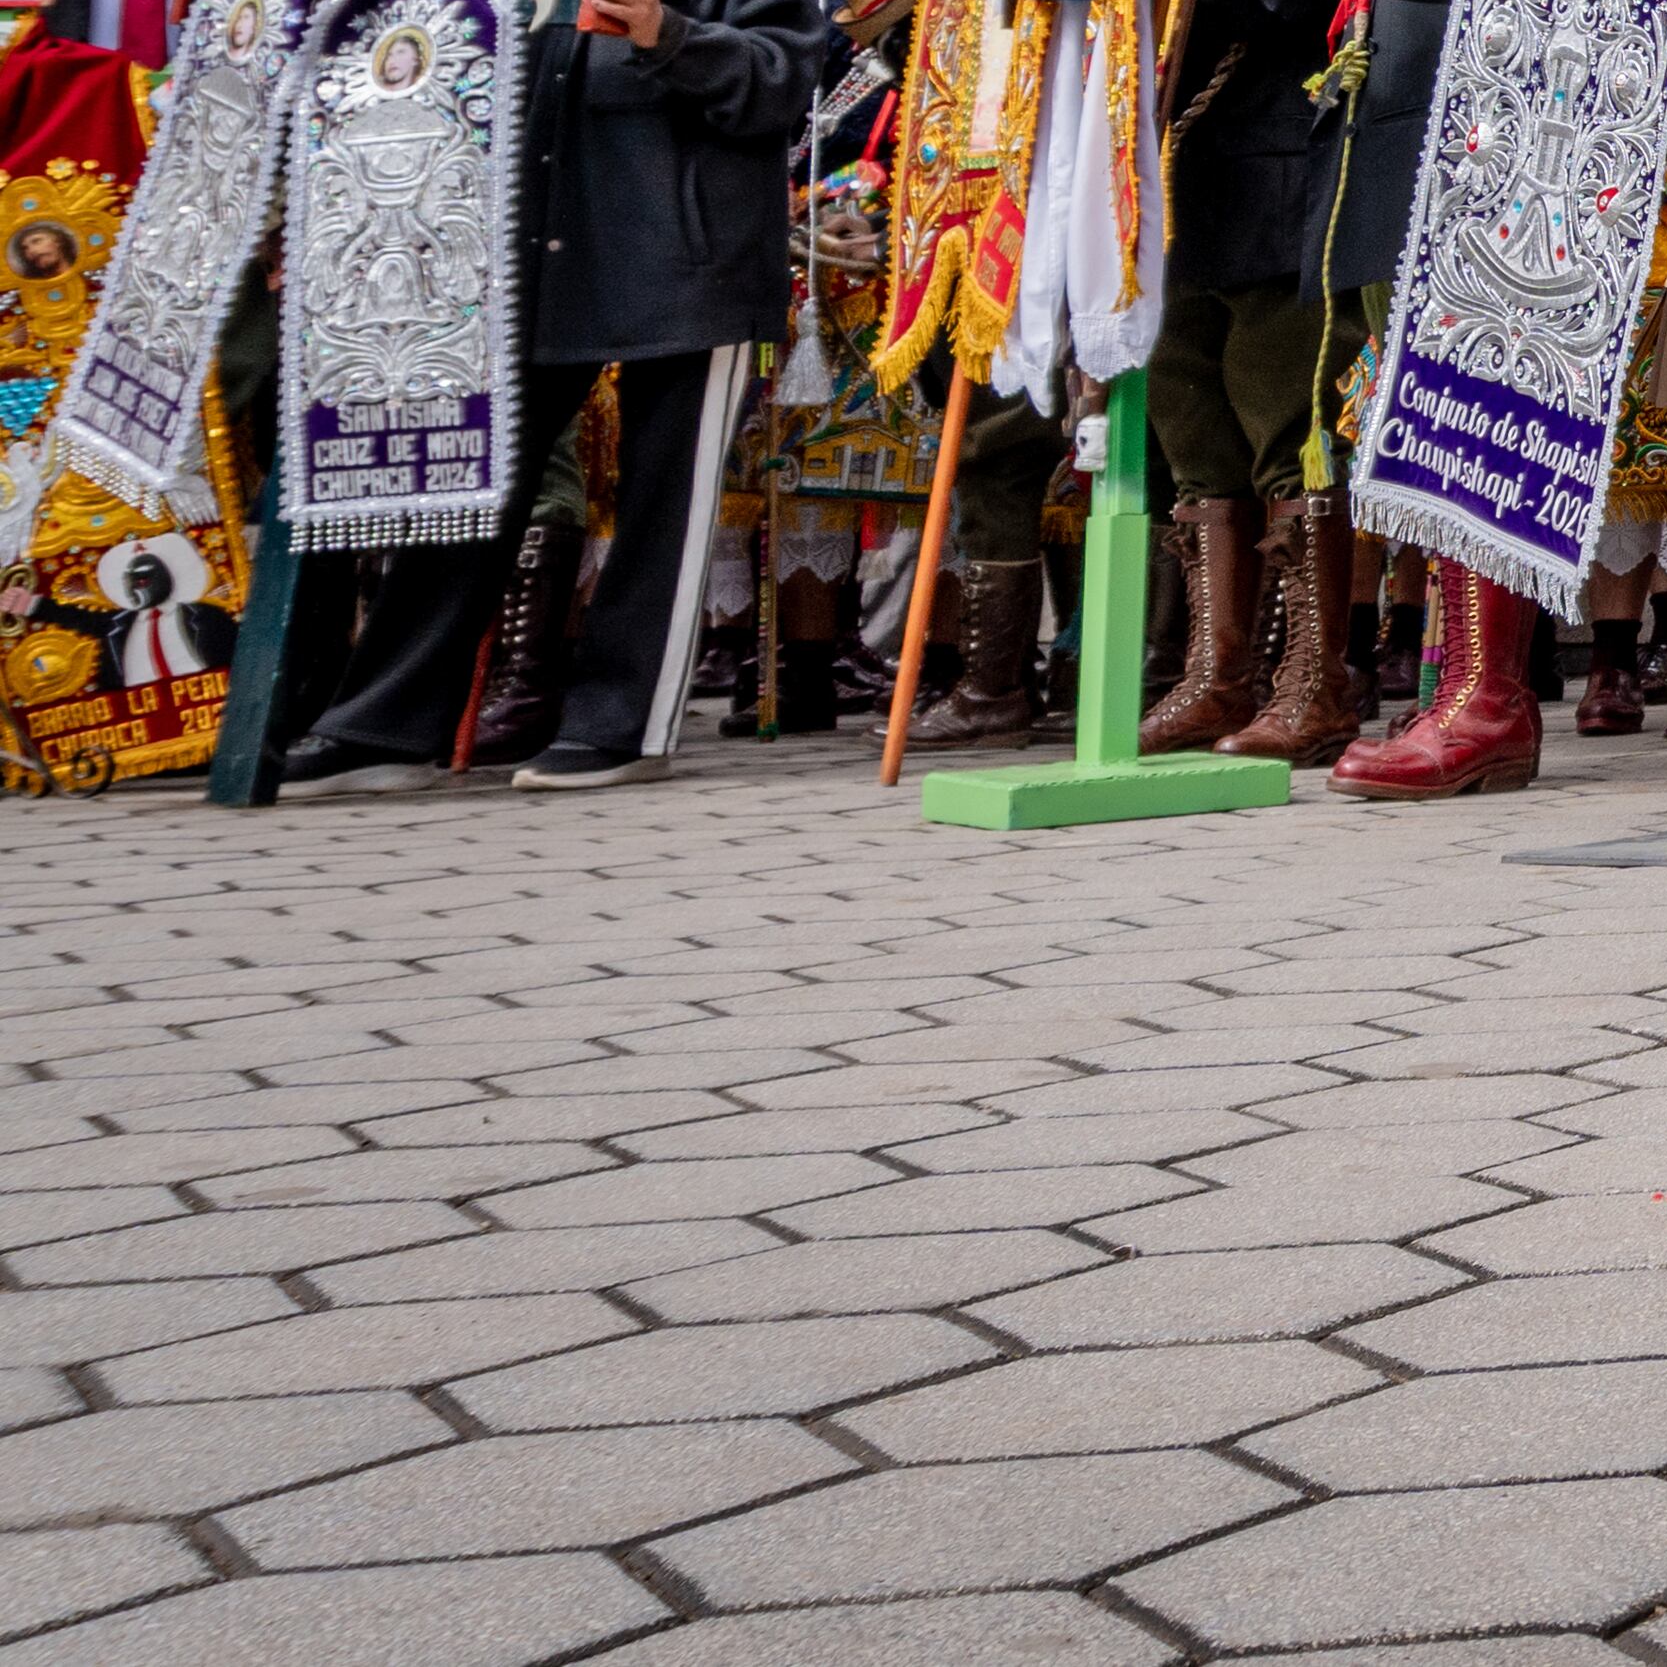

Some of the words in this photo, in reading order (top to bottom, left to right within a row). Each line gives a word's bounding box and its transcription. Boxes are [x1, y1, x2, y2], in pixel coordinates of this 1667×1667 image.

[337, 398, 465, 434] SANTISIMA
[1399, 370, 1491, 439] Conjunto
[1490, 411, 1519, 453] de
[1520, 419, 1602, 489] Shapish
[313, 435, 376, 469] CRUZ
[386, 433, 421, 464] DE
[426, 428, 485, 461] MAYO
[312, 464, 415, 502] CHUPACA
[424, 460, 484, 493] 2026
[1375, 416, 1524, 520] Chaupishapi
[1533, 483, 1594, 545] 2026
[126, 686, 159, 717] LA
